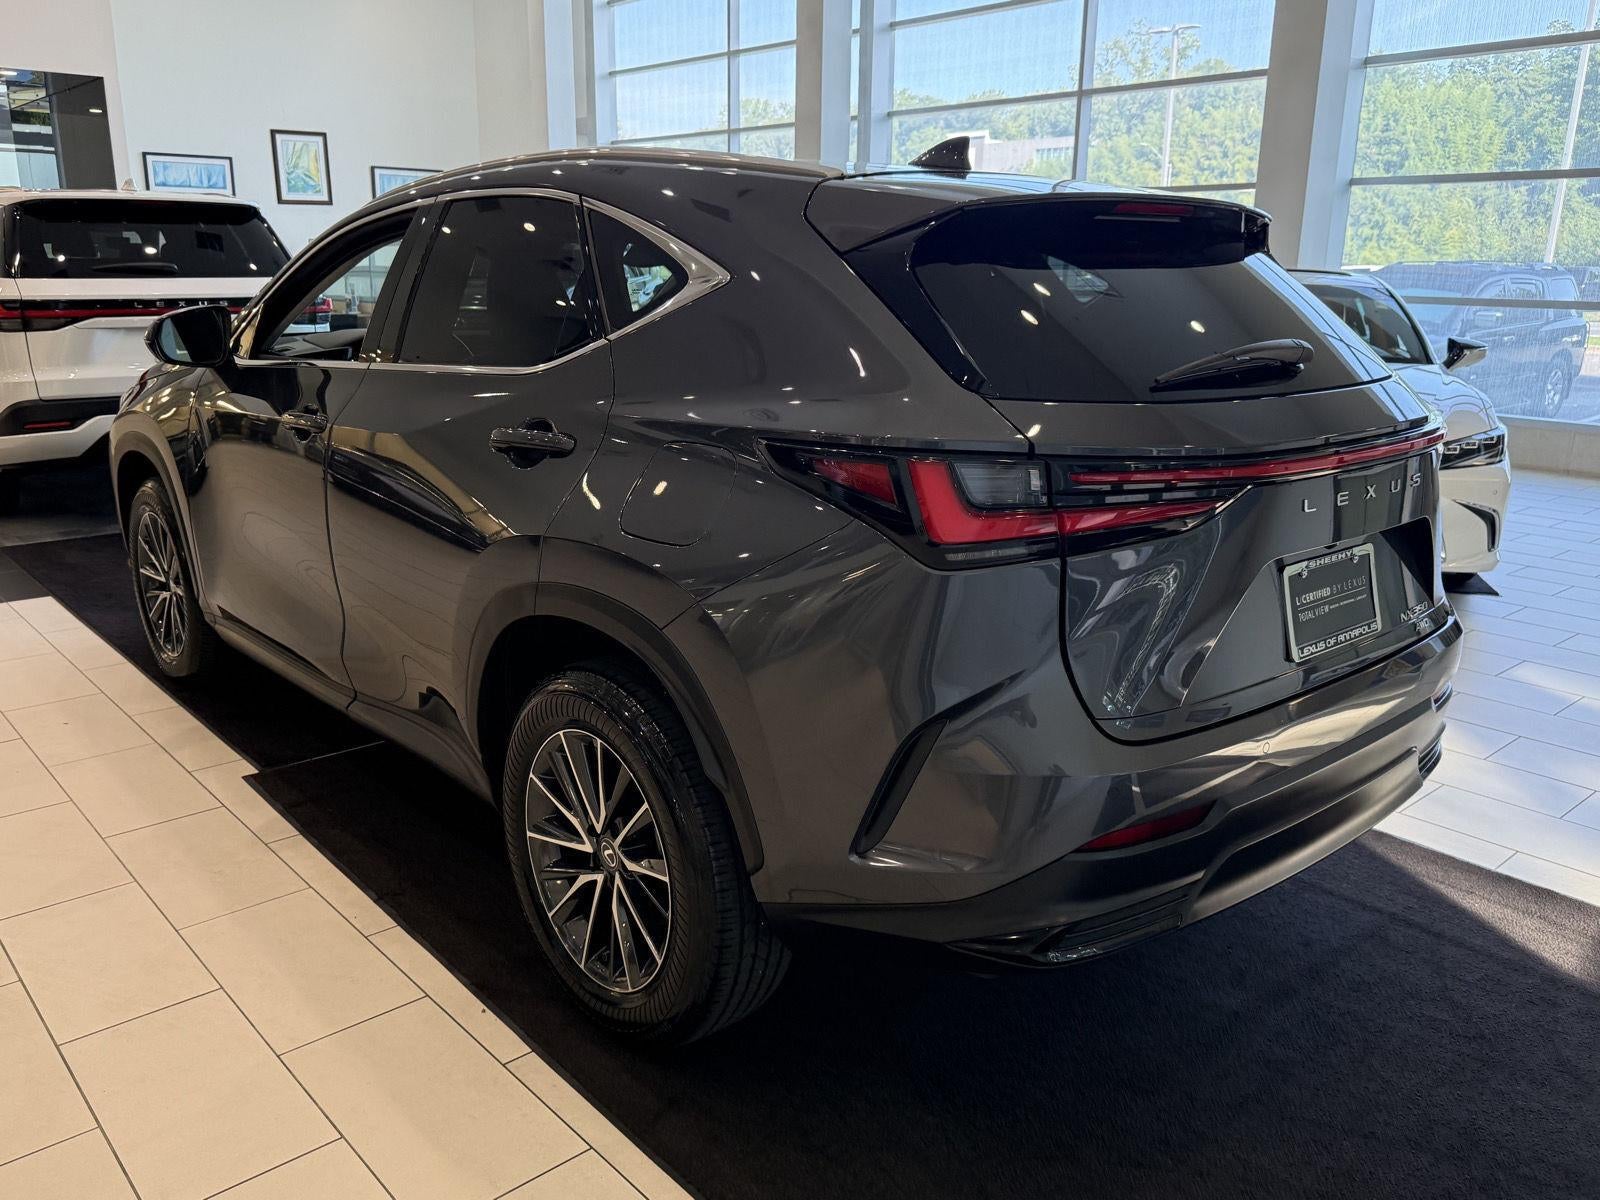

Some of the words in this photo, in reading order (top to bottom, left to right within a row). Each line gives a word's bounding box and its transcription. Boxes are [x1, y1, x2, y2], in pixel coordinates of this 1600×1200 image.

[1302, 473, 1421, 513] LEXUS
[1308, 549, 1353, 568] SHEEHY
[1343, 576, 1366, 590] LEXUS
[1298, 641, 1326, 657] LEXUS
[1326, 636, 1337, 647] OF
[1338, 622, 1378, 643] ANNAPOLIS
